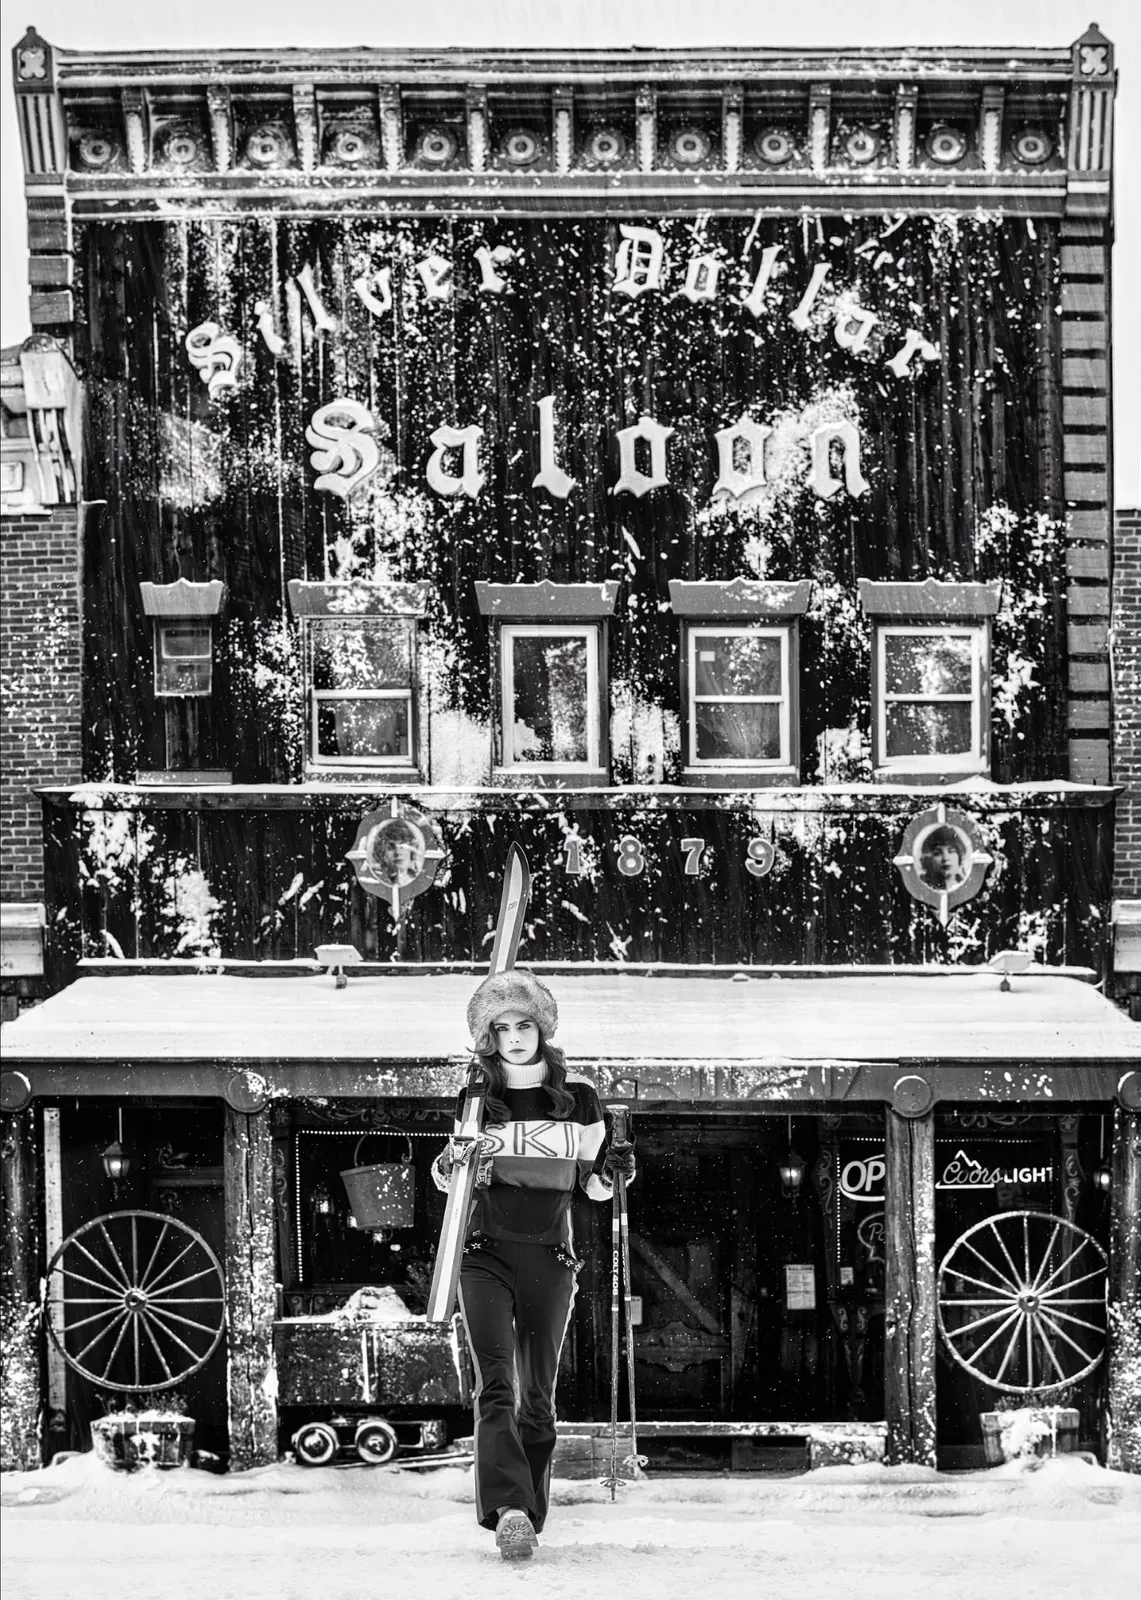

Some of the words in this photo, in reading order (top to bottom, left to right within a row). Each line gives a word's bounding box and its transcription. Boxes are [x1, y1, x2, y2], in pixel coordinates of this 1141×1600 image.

[185, 245, 515, 400] Silver
[612, 224, 941, 378] Dollar
[305, 394, 870, 499] Saloon
[563, 837, 774, 876] 1879
[480, 1122, 575, 1158] SKI
[841, 1160, 886, 1193] OP
[943, 1161, 1003, 1184] Coors
[1004, 1167, 1053, 1183] LIGHT
